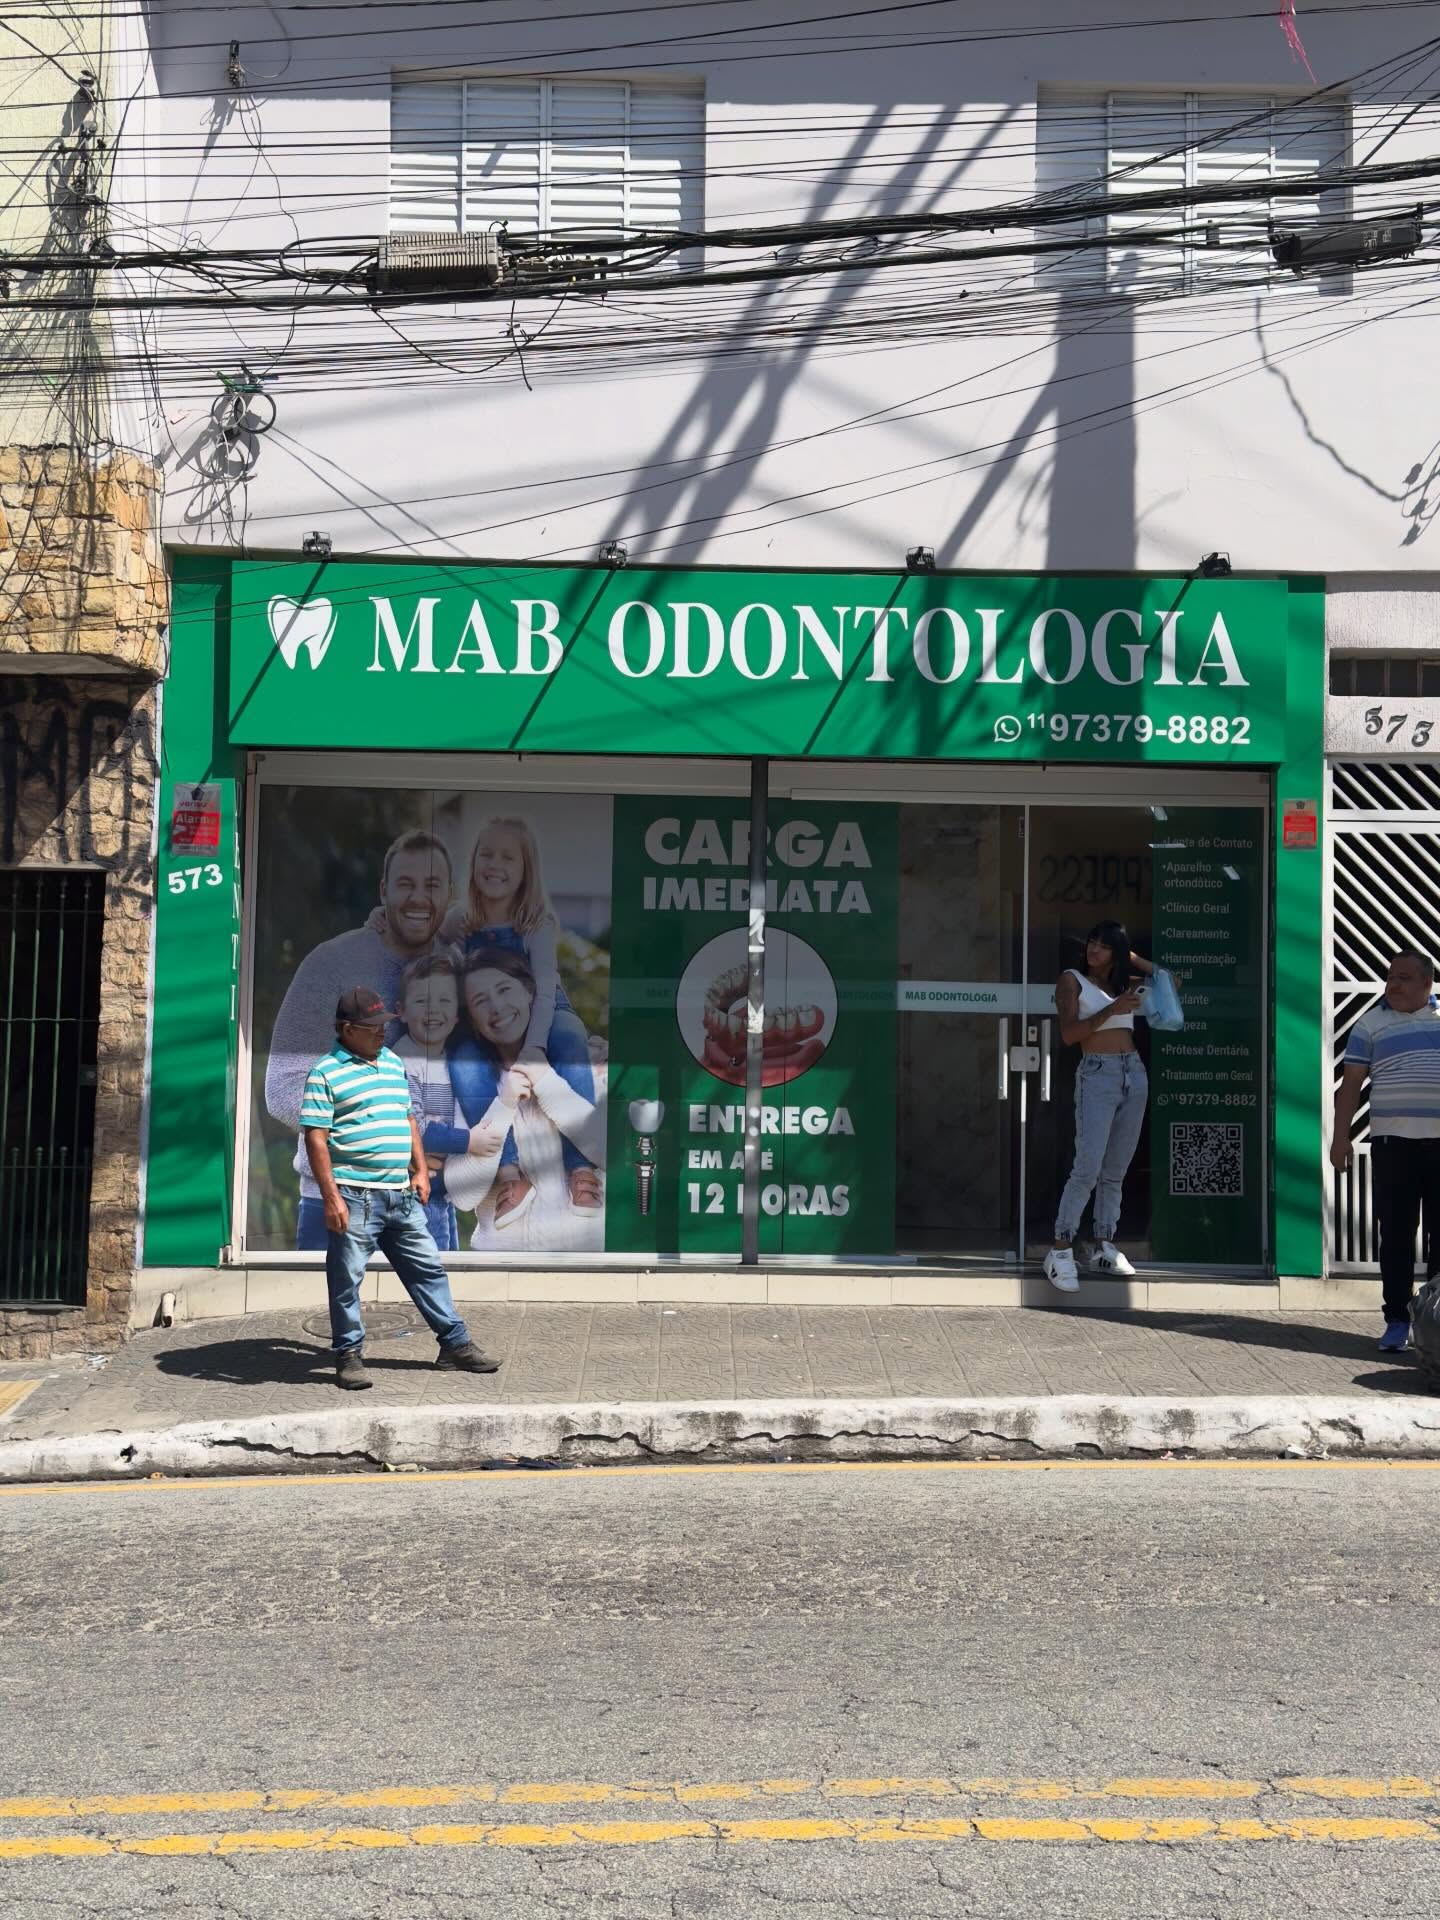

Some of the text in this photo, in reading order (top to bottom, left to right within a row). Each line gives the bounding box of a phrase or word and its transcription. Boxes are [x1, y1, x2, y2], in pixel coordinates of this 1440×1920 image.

[366, 595, 1250, 687] MAB ODONTOLOGIA
[1050, 715, 1251, 746] 97379-8882
[1365, 705, 1435, 747] 573
[1198, 837, 1210, 848] de
[1213, 838, 1253, 849] Contato
[1166, 861, 1212, 874] Aparelho
[168, 863, 224, 894] 573
[1166, 902, 1230, 914] Clínico Geral
[1166, 928, 1230, 939] Clareamento
[1166, 952, 1237, 966] Harmonização
[905, 991, 926, 1001] MAB
[928, 991, 998, 1003] ODONTOLOGIA
[1166, 1044, 1249, 1056] Prótese Dentária
[1166, 1070, 1253, 1081] Tratamento em Geral
[688, 1148, 774, 1171] EM AÉ
[688, 1182, 725, 1214] 12
